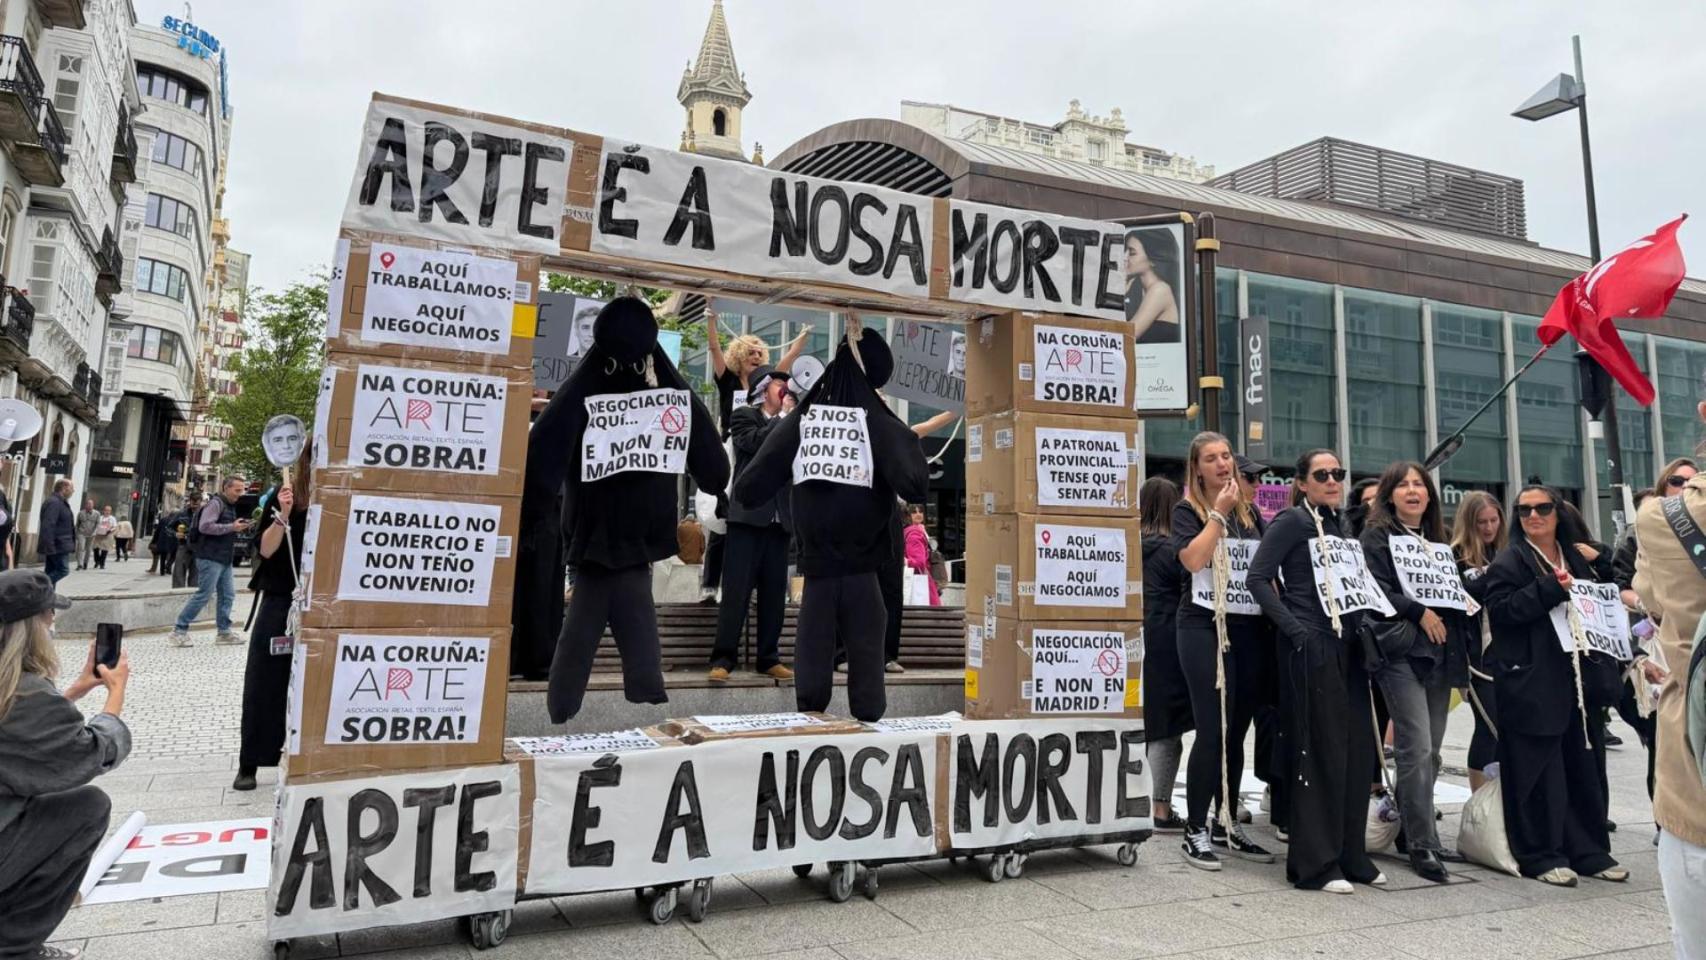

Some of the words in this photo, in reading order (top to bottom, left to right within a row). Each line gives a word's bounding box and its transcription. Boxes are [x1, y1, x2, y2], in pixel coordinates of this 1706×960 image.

[359, 117, 565, 240] ARTE
[598, 144, 650, 240] É
[663, 166, 716, 251] A
[769, 176, 927, 286] NOSA
[952, 208, 1125, 310] MORTE
[421, 261, 469, 278] AQUÍ
[371, 271, 511, 300] TRABALLAMOS:
[417, 304, 466, 321] AQUÍ
[371, 317, 500, 342] NEGOCIAMOS
[896, 322, 942, 356] ARTE
[1037, 332, 1058, 345] NA
[1062, 334, 1122, 350] CORUÑA:
[1045, 348, 1115, 375] ARTE
[1247, 334, 1263, 405] fnac
[362, 374, 395, 393] NA
[403, 378, 503, 400] CORUÑA:
[1044, 382, 1117, 404] SOBRA!
[589, 391, 688, 414] NEGOCIACIÓN
[370, 397, 486, 434] ARTE
[588, 414, 638, 431] AQUÍ...
[586, 444, 595, 459] E
[610, 434, 651, 457] NON
[664, 435, 687, 451] EN
[800, 444, 835, 458] NON
[839, 446, 859, 460] SE
[1041, 438, 1051, 450] A
[1054, 439, 1120, 453] PATRONAL
[363, 442, 486, 471] SOBRA!
[586, 452, 658, 480] MADRID
[1040, 454, 1127, 468] PROVINCIAL...
[802, 462, 852, 479] XOGA!
[1050, 471, 1088, 484] TENSE
[1092, 472, 1117, 486] QUE
[1058, 487, 1107, 500] SENTAR
[354, 509, 460, 530] TRABALLO
[466, 517, 496, 533] NO
[1672, 513, 1695, 538] YOU
[361, 531, 468, 552] COMERCIO
[474, 538, 485, 552] E
[1067, 534, 1096, 548] AQUÍ
[365, 553, 414, 570] NON
[422, 553, 474, 573] TEÑO
[1038, 547, 1125, 563] TRABALLAMOS:
[359, 574, 475, 594] CONVENIO!
[1067, 569, 1097, 583] AQUÍ
[1040, 584, 1120, 598] NEGOCIAMOS
[342, 646, 376, 662] NA
[383, 641, 485, 662] CORUÑA:
[1035, 634, 1123, 649] NEGOCIACIÓN
[1035, 651, 1079, 665] AQUÍ...
[349, 667, 468, 701] ARTE
[1035, 678, 1044, 693] E
[1055, 678, 1093, 693] NON
[1105, 678, 1124, 693] EN
[1035, 697, 1099, 712] MADRID
[341, 715, 467, 742] SOBRA!
[274, 781, 503, 916] ARTE
[567, 753, 622, 867] É
[652, 760, 710, 863] A
[752, 744, 934, 851] NOSA
[953, 729, 1151, 833] MORTE
